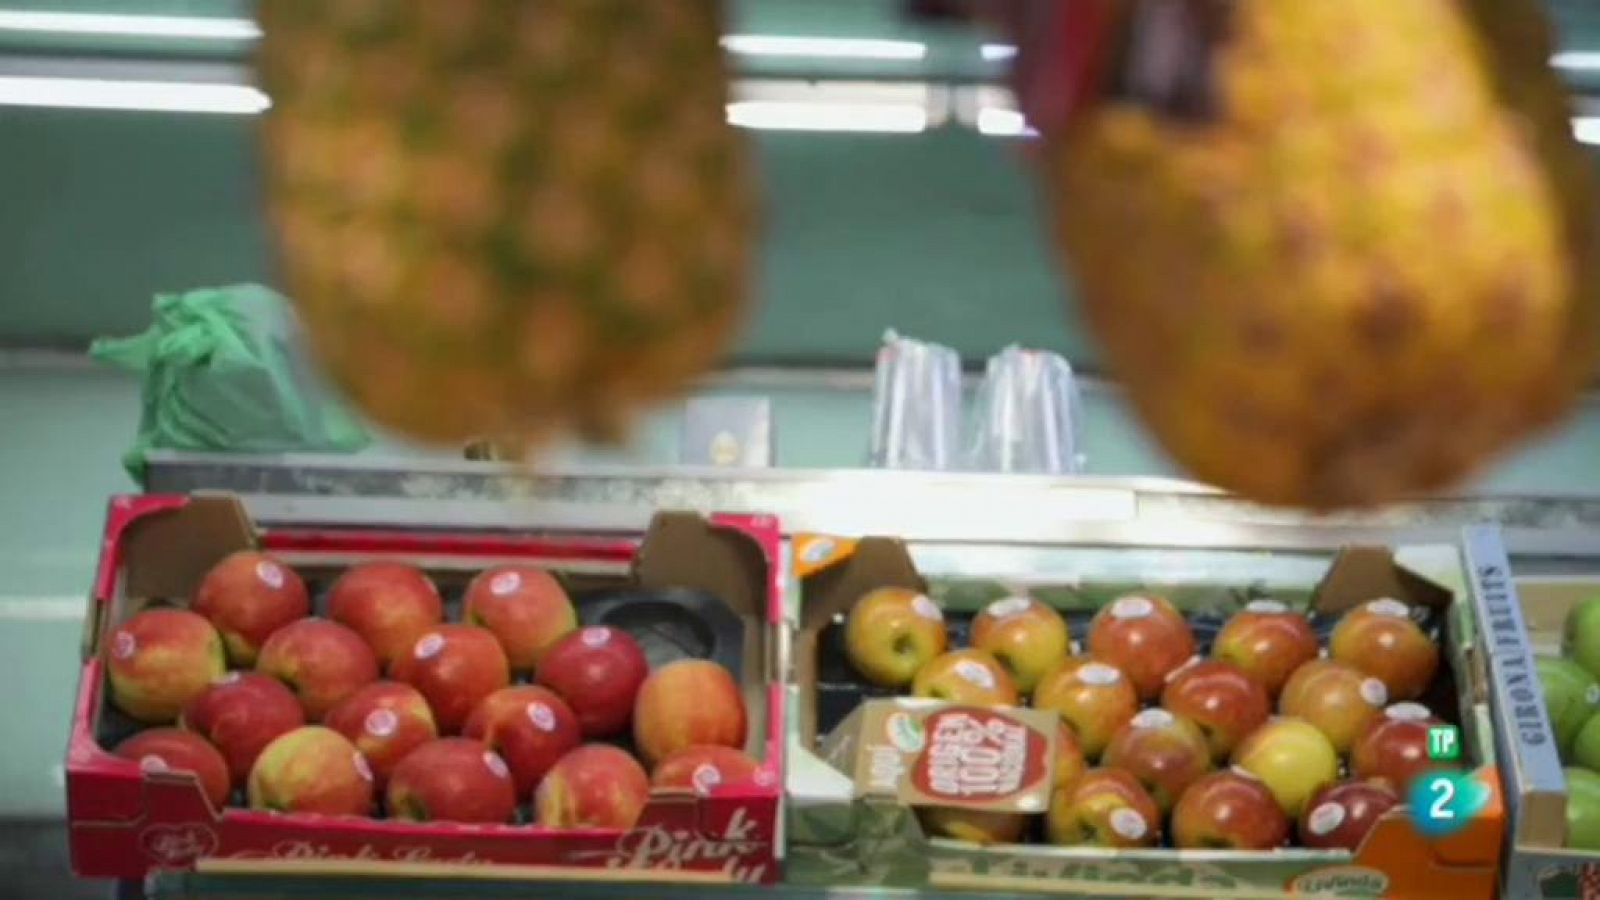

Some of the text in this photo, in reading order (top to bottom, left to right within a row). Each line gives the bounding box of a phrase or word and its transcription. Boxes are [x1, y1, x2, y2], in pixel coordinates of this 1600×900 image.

[1477, 565, 1547, 747] GIRONA FRUITS
[958, 717, 1005, 796] 100%
